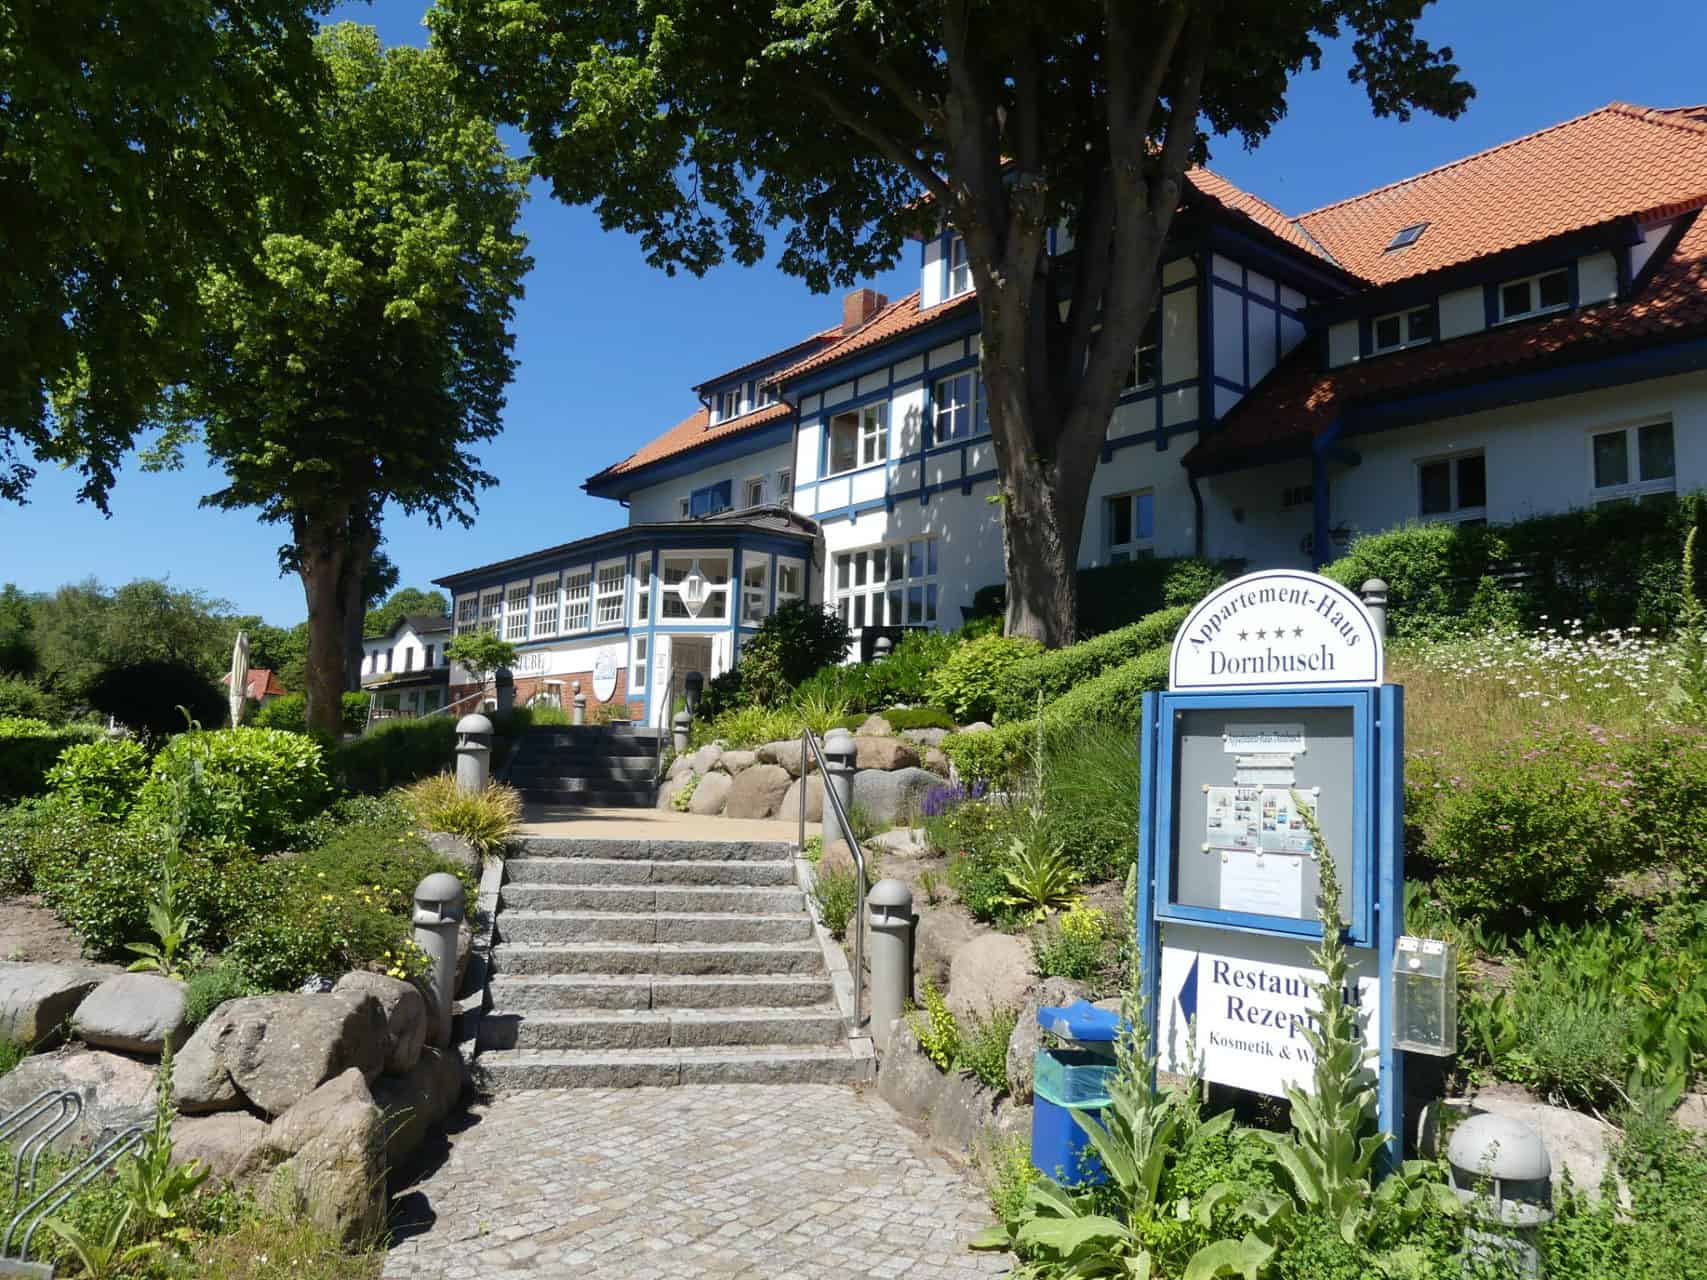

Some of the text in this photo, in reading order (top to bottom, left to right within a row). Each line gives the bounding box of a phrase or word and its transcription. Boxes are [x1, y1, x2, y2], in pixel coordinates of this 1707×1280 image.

[1189, 587, 1361, 653] Appartement-Haus
[1211, 645, 1334, 675] Dornbusch
[1210, 1032, 1274, 1057] Kosmetik
[1279, 1046, 1291, 1060] &
